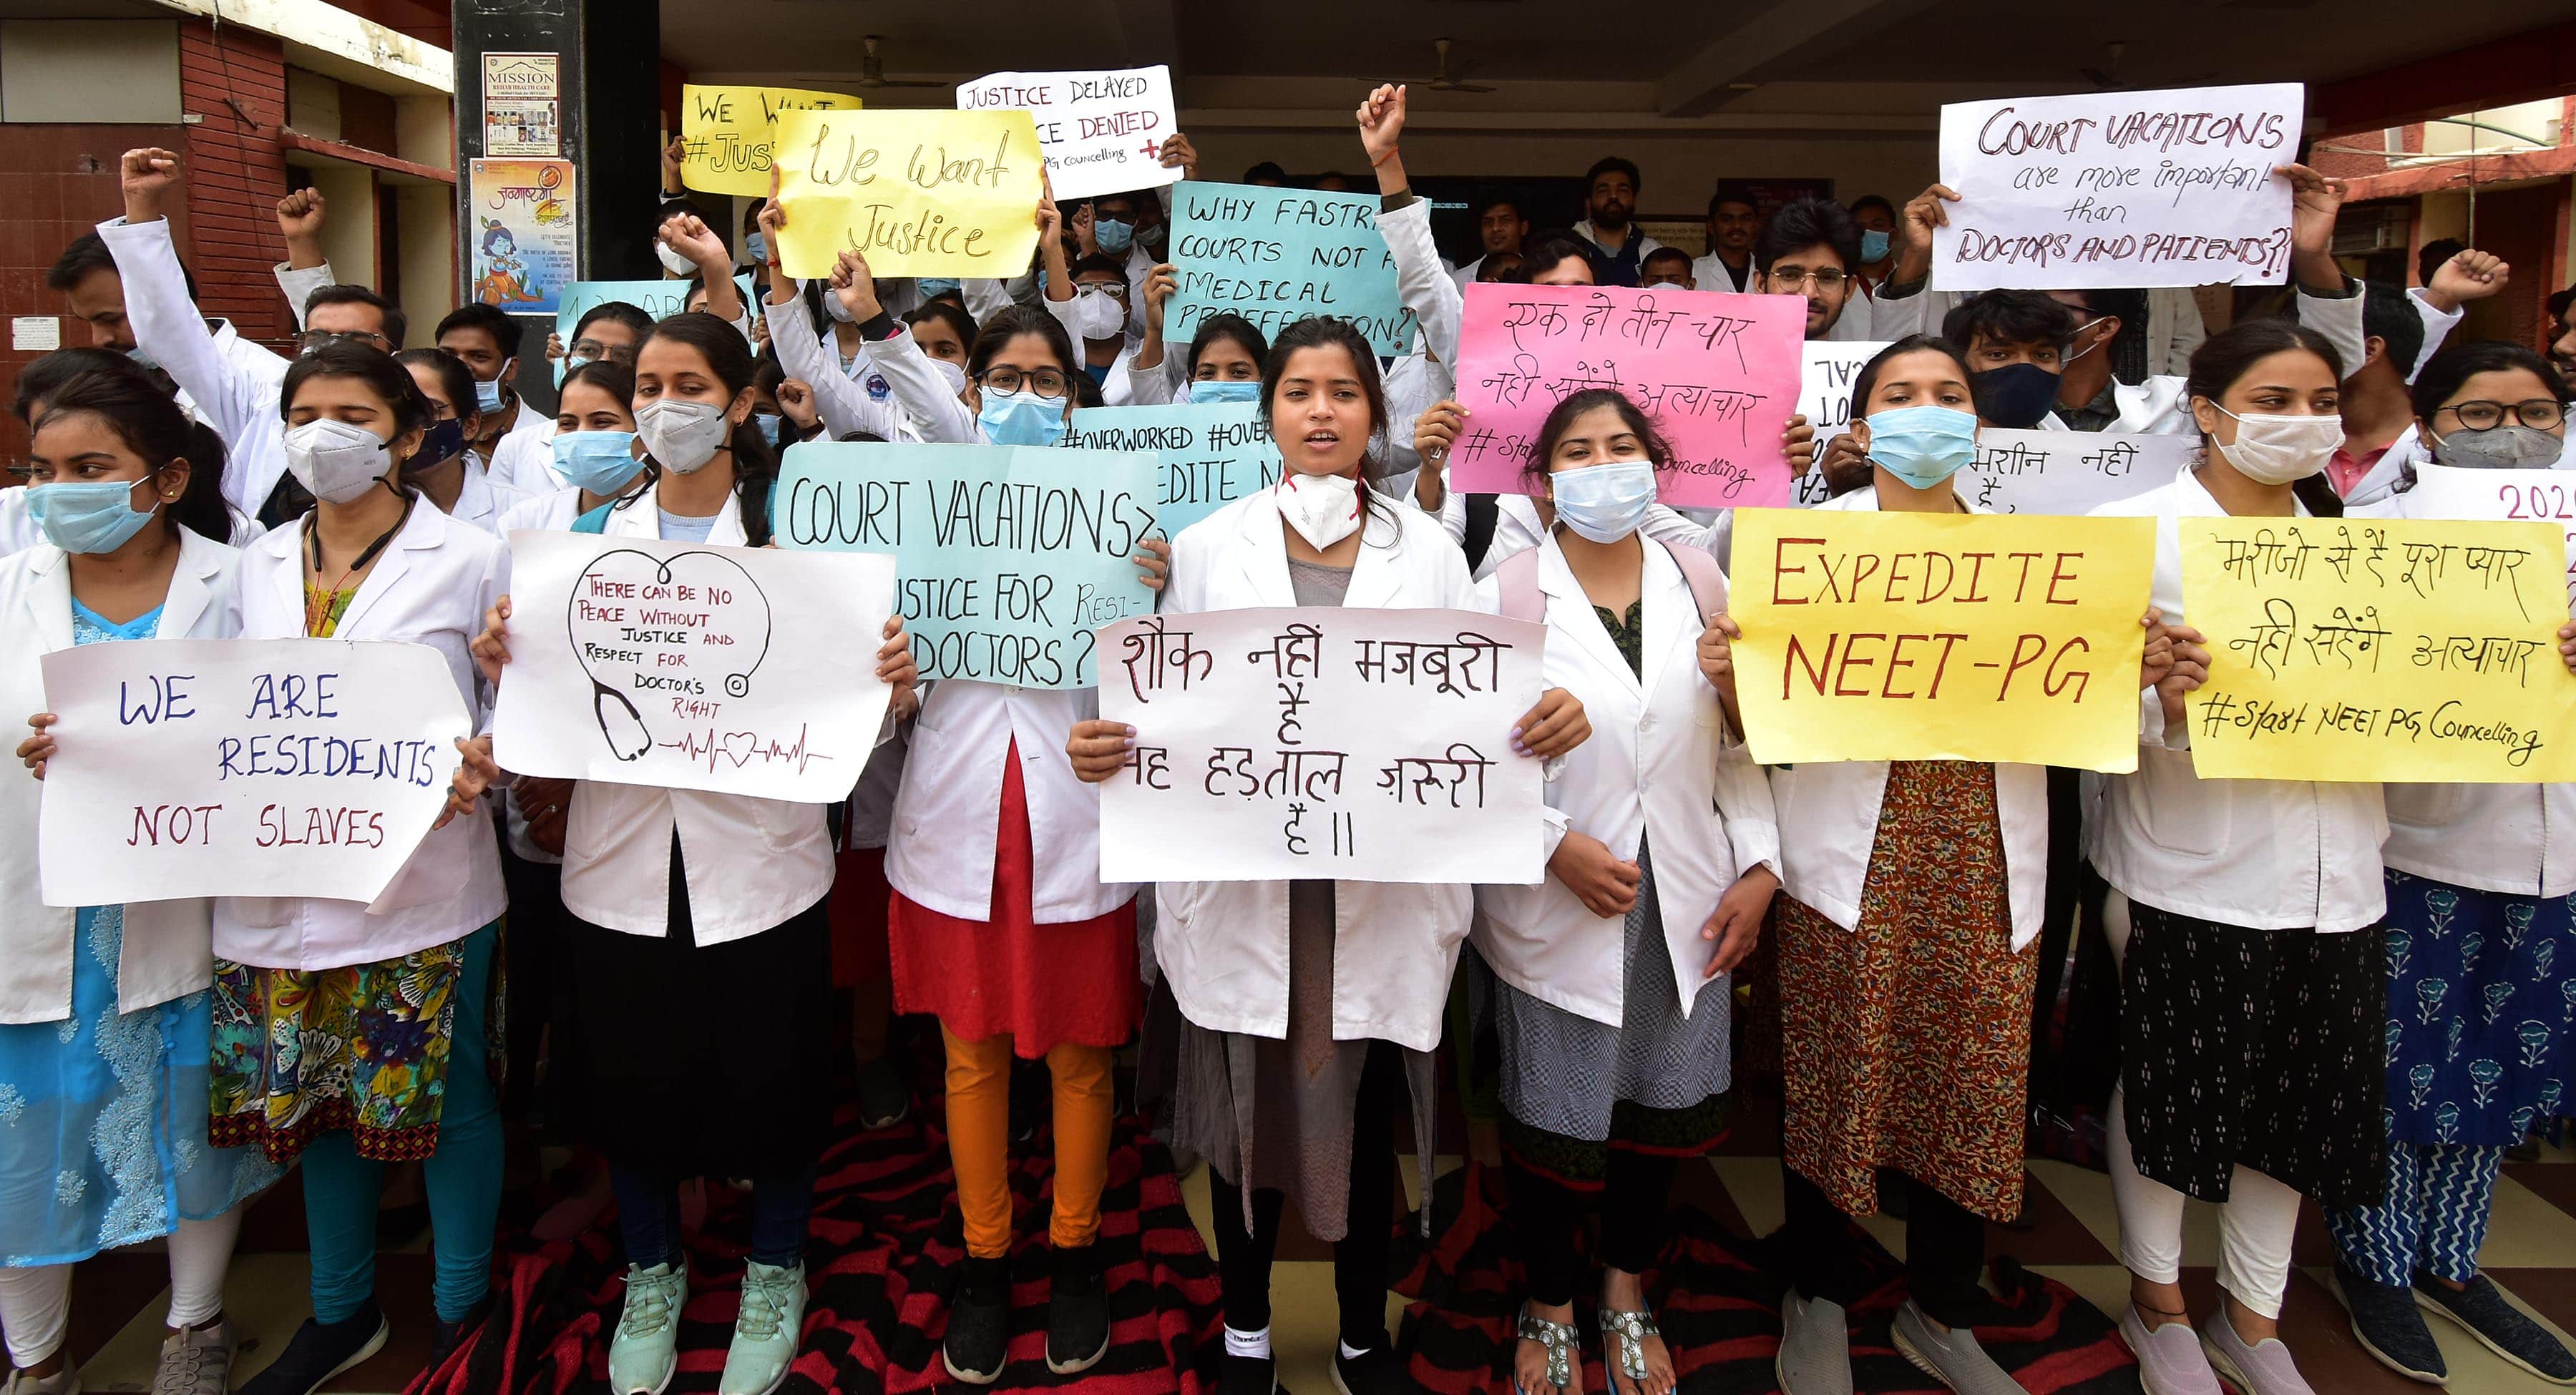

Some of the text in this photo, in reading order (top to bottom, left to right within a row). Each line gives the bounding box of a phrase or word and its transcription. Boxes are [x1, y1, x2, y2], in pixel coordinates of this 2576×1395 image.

[489, 73, 555, 84] MISSION
[966, 75, 1148, 109] JUSTICE DELAYED
[695, 93, 733, 124] WE
[1077, 111, 1159, 140] DENIED
[1978, 107, 2285, 156] COURT VACATIONS
[809, 123, 1010, 190] We Want
[2014, 157, 2273, 208] are more important
[847, 204, 992, 258] Justice
[1188, 195, 1377, 231] WHY FASTR
[2062, 197, 2127, 224] than
[1178, 234, 1284, 266] COURTS
[1311, 246, 1369, 270] NOT
[1955, 227, 2072, 268] DOCTORS
[2071, 233, 2137, 263] AND
[1184, 272, 1337, 304] MEDICAL
[1503, 291, 1757, 375] एक दो तीन चार
[1636, 382, 1768, 449] अत्याचार
[1968, 440, 2140, 476] मशीन नहीं
[789, 477, 910, 547] COURT
[2499, 484, 2576, 519] 202
[585, 572, 733, 606] THERE CAN BE NO
[1771, 537, 2085, 606] EXPEDITE
[2323, 524, 2358, 584] से
[2363, 527, 2389, 588] है
[2400, 542, 2459, 599] पूरा
[2464, 546, 2532, 624] प्यार
[577, 599, 711, 628] PEACE WITHOUT
[994, 573, 1054, 628] FOR
[584, 642, 689, 668] RESPECT FOR
[620, 627, 735, 646] JUSTICE AND
[2303, 605, 2393, 674] सहेंगे
[2411, 634, 2547, 689] अत्याचार
[1121, 616, 1513, 704] शौक नहीं मजबूरी
[119, 672, 339, 726] WE ARE
[634, 672, 706, 696] DOCTOR'S
[671, 696, 722, 720] RIGHT
[1277, 682, 1310, 746] है
[2313, 700, 2382, 735] NEET
[2384, 708, 2424, 743] PG
[218, 734, 436, 788] RESIDENTS
[1204, 746, 1350, 803] हड़ताल
[1376, 743, 1500, 809] ज़रूरी
[126, 803, 384, 849] NOT SLAVES
